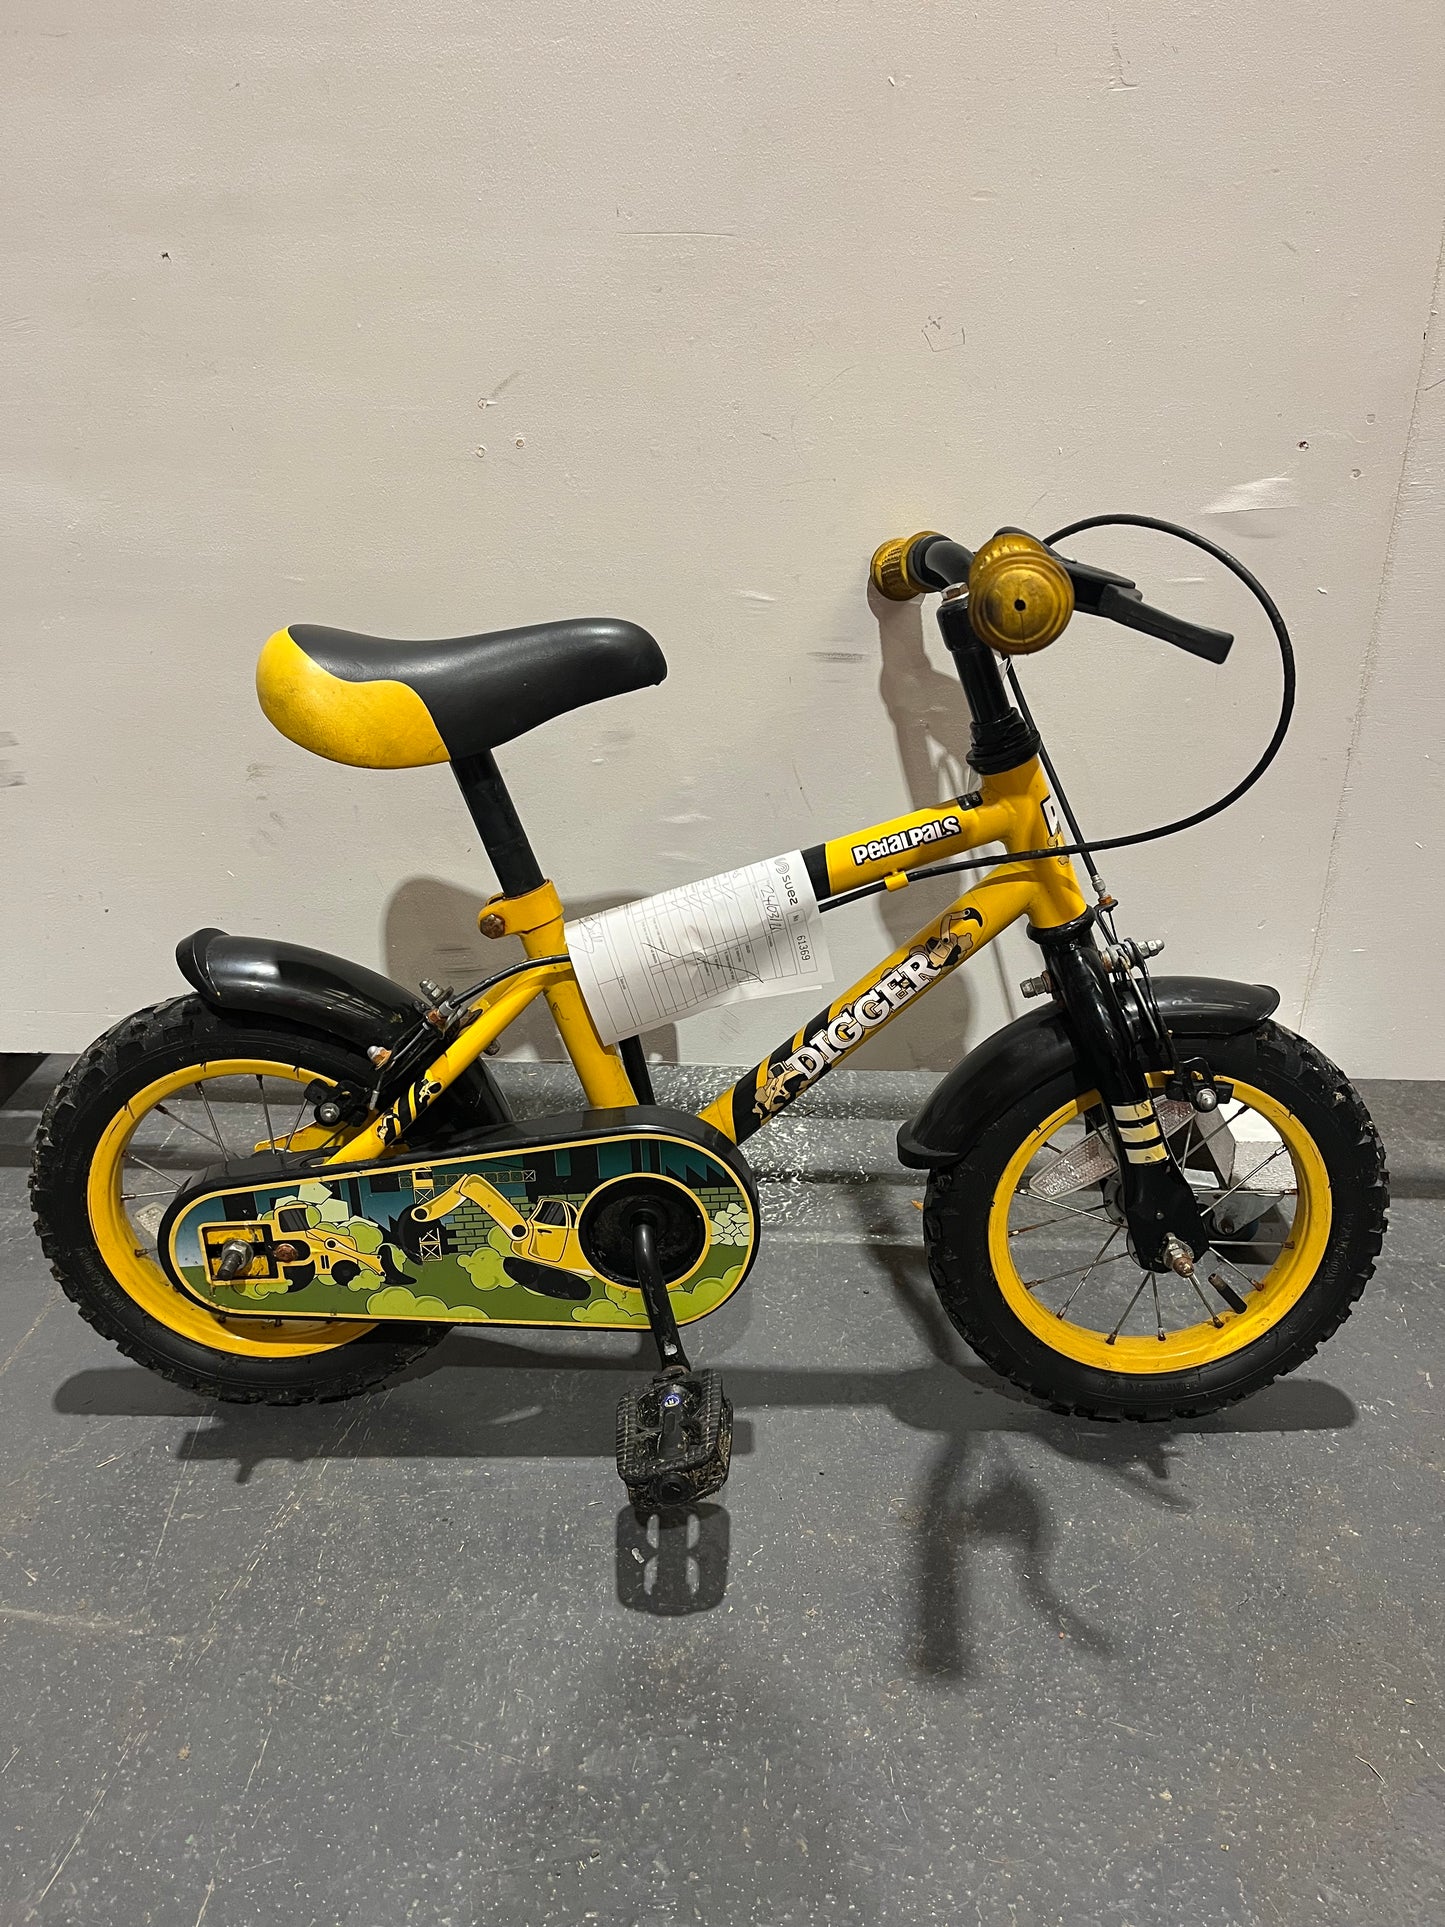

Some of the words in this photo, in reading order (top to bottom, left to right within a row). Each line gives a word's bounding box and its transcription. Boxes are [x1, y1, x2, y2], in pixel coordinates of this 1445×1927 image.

[782, 876, 798, 906] suez
[797, 935, 810, 961] 61369
[786, 953, 942, 1080] DIGGER
